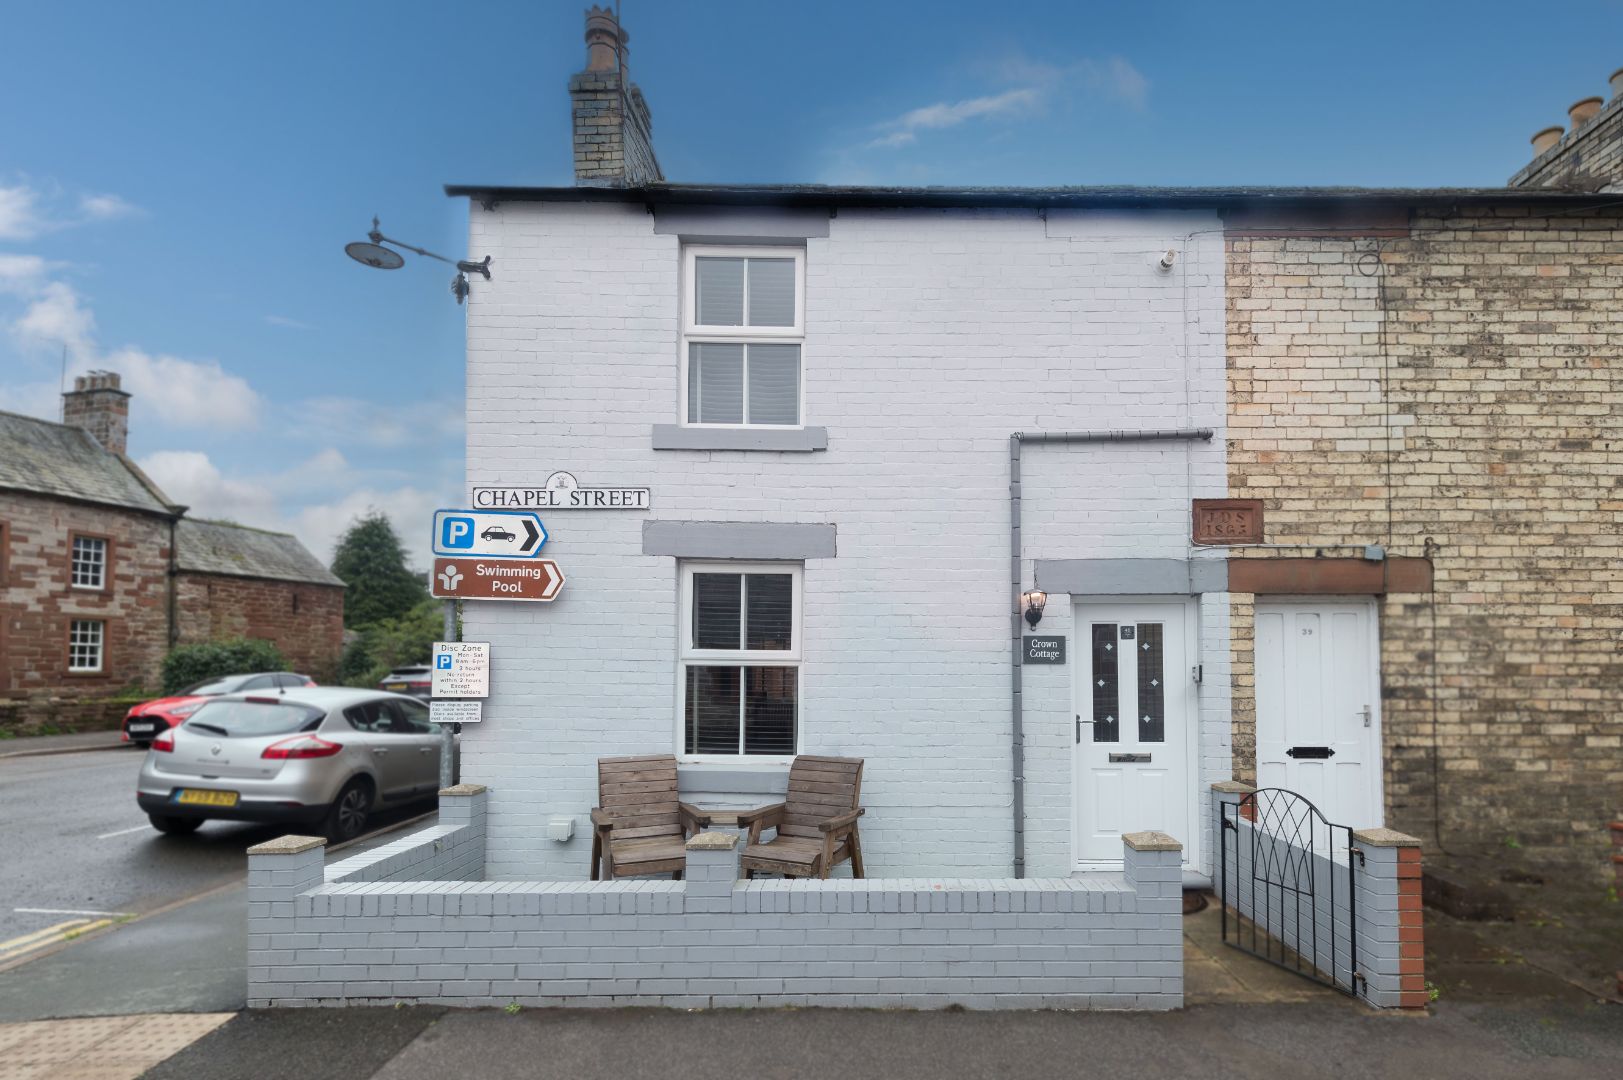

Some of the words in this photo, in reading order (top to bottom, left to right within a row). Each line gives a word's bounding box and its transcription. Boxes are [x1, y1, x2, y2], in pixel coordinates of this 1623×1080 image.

[477, 490, 560, 506] CHAPEL
[570, 490, 646, 506] STREET
[449, 521, 469, 545] P
[476, 563, 541, 580] Swimming
[492, 581, 523, 593] Pool
[441, 644, 459, 652] Disc
[462, 644, 482, 652] Zone
[1031, 638, 1058, 648] Crown
[1029, 648, 1060, 661] Cottage
[440, 656, 450, 668] P
